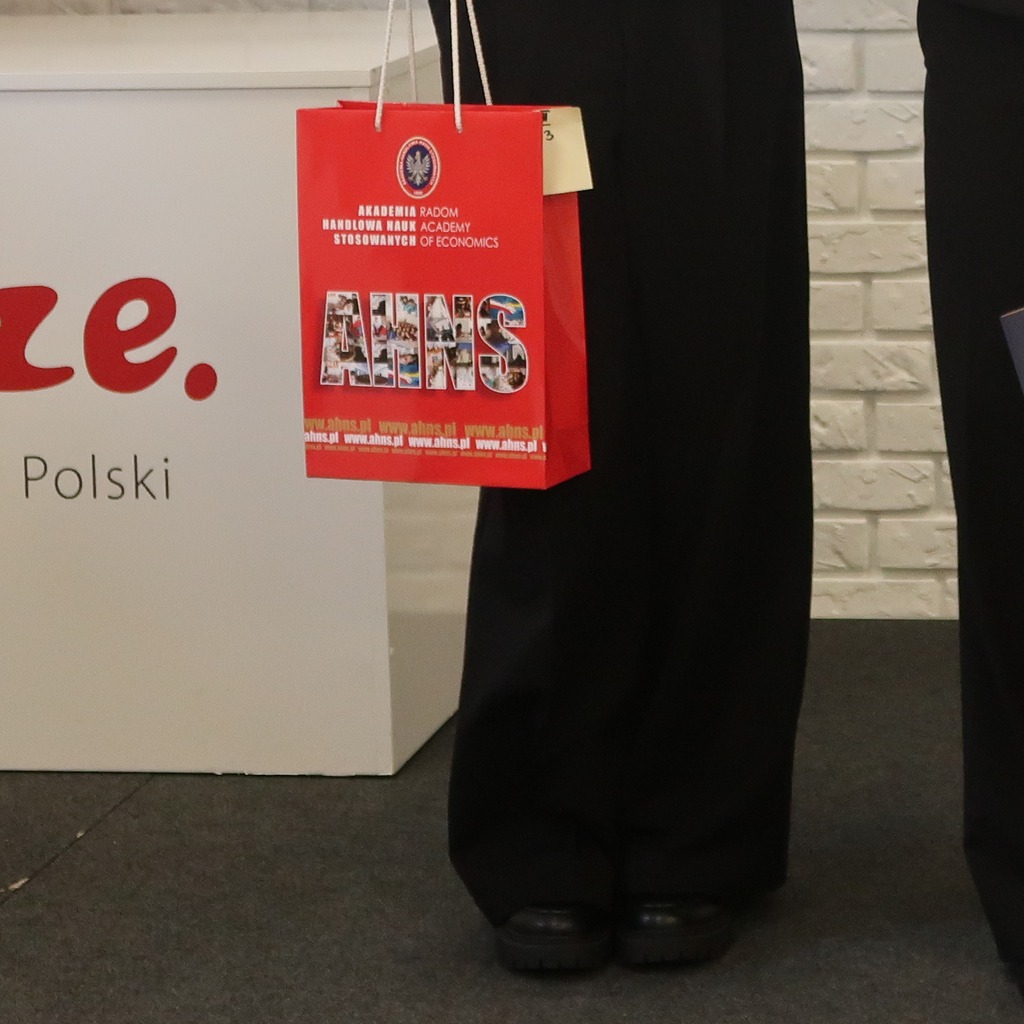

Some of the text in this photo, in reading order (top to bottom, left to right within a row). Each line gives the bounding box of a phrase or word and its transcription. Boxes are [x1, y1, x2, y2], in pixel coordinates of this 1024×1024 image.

[358, 205, 417, 217] AKADEMIA
[420, 207, 459, 218] RADOM
[322, 218, 417, 232] HANDLOWA NAUK
[420, 222, 471, 233] ACADEMY
[333, 233, 417, 246] STOSOWANYCH
[420, 236, 499, 249] OF ECONOMICS
[319, 290, 530, 394] AHNS
[343, 432, 404, 448] www.ahns.pl
[408, 436, 470, 451] www.ahns.pl
[475, 439, 538, 454] www.ahns.pl
[24, 454, 170, 500] Polski
